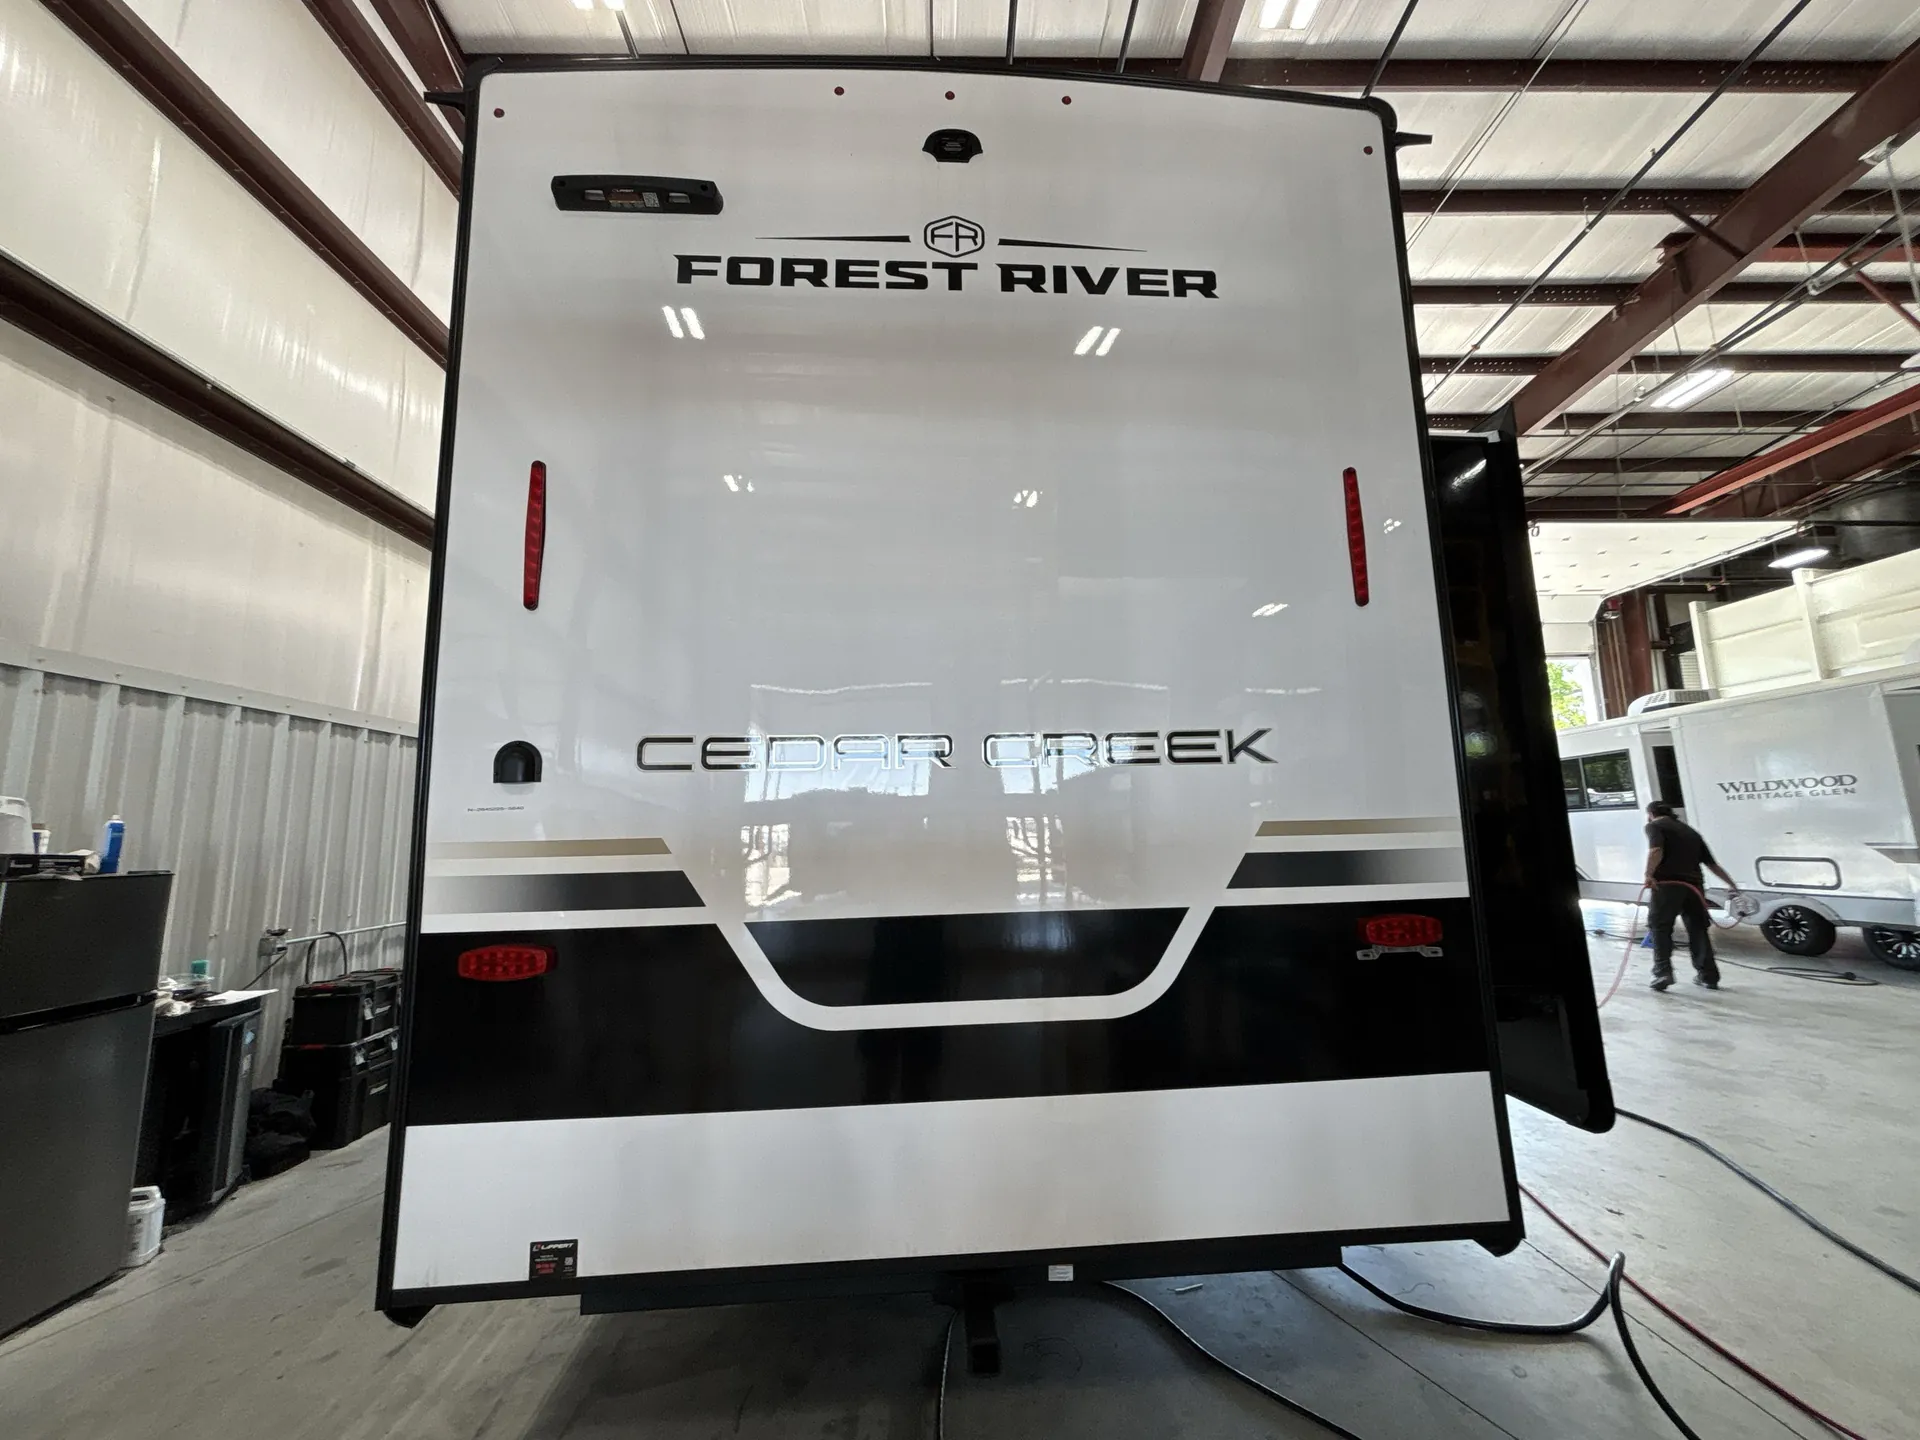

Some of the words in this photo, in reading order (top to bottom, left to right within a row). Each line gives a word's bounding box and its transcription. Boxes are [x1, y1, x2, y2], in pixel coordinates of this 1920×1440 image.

[673, 254, 979, 291] FOREST
[995, 263, 1220, 299] RIVER
[636, 734, 957, 772] CEDAR
[981, 728, 1279, 768] CREEK
[1718, 774, 1858, 794] WILDWOOD
[1726, 790, 1804, 801] HERITAGE
[1809, 787, 1857, 797] GLEN
